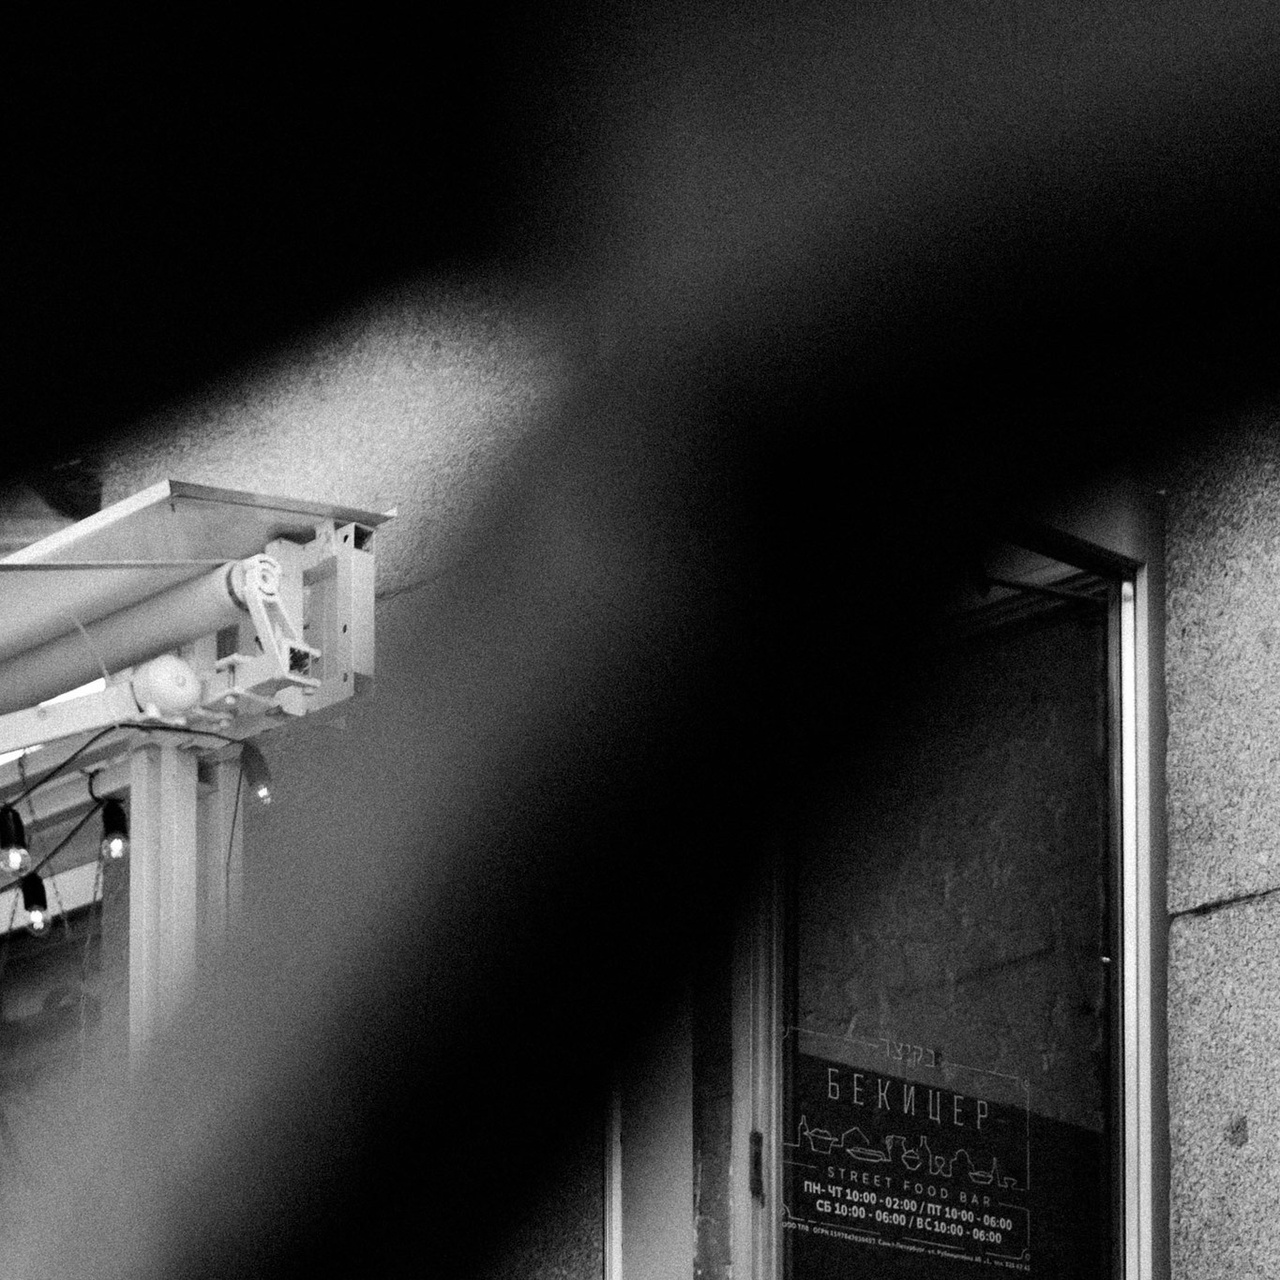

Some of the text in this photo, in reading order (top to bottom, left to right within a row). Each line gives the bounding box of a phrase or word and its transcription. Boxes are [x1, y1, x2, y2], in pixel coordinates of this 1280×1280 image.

[827, 1067, 989, 1130] БЕКИЦЕР
[828, 1166, 991, 1208] STREET FOOD BAR
[828, 1184, 843, 1198] ЧТ
[845, 1188, 877, 1205] 10:00
[885, 1196, 917, 1213] 02:00
[927, 1203, 942, 1217] ПТ
[945, 1206, 975, 1223] 10:00
[983, 1214, 1013, 1231] 06:00
[816, 1199, 832, 1214] СБ
[834, 1202, 866, 1219] 10:00
[875, 1210, 907, 1227] 06:00
[916, 1217, 932, 1231] ВС
[934, 1221, 963, 1237] 10:00
[972, 1228, 1002, 1245] 06:00
